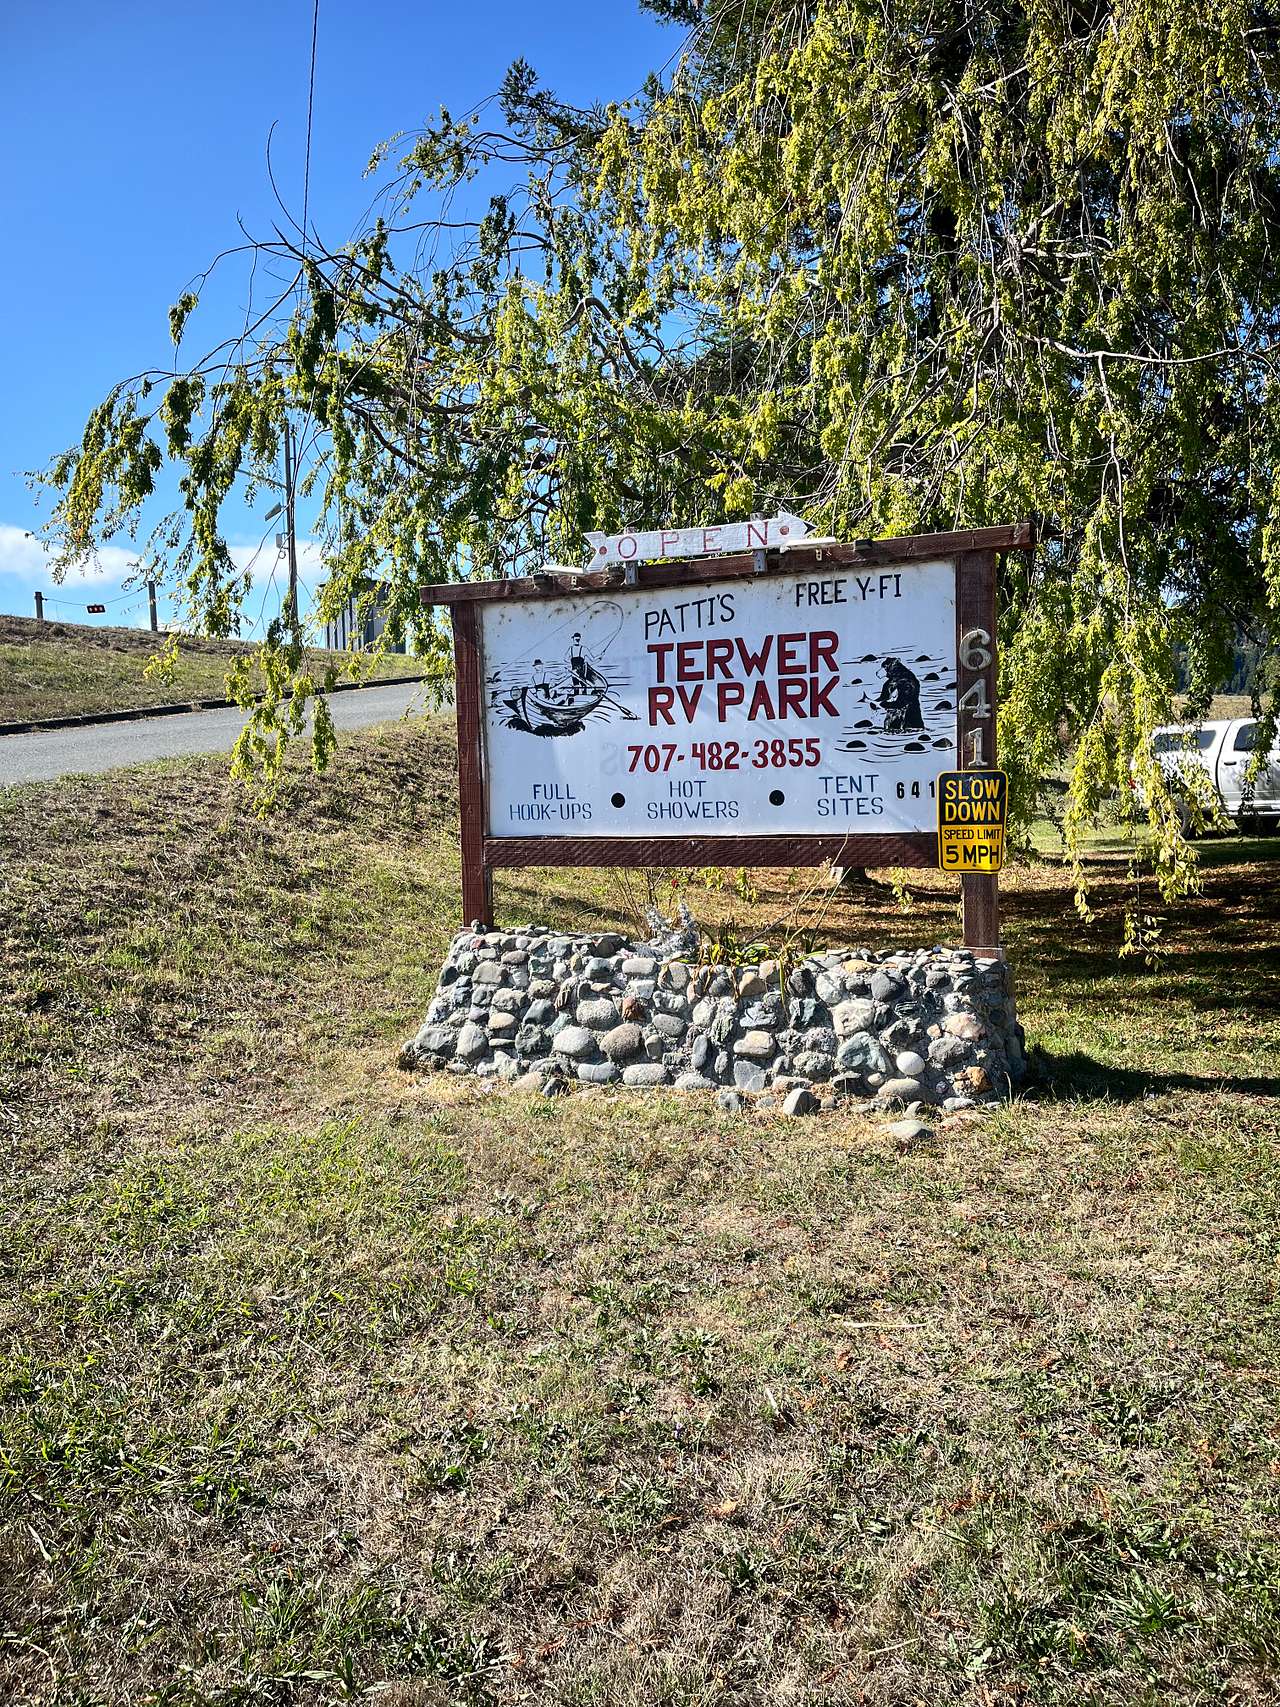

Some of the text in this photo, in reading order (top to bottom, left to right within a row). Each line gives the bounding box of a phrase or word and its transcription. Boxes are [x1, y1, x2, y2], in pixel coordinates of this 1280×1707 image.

[617, 522, 769, 559] OPEN
[796, 574, 902, 607] FREE Y-FI
[644, 593, 735, 640] PATTI'S
[647, 630, 840, 683] TERWER
[649, 675, 841, 726] RV PARK
[628, 738, 821, 773] 707-482-3855
[533, 783, 576, 801] FULL
[669, 780, 707, 799] HOT
[818, 774, 880, 795] TENT
[945, 779, 1000, 800] SLOW
[509, 803, 593, 821] HOOK-UPS
[647, 801, 739, 819] SHOWERS
[817, 797, 884, 817] SITES
[944, 801, 1000, 822] DOWN
[943, 828, 1001, 840] SPEED LIMIT
[946, 845, 1000, 865] 5 MPH
